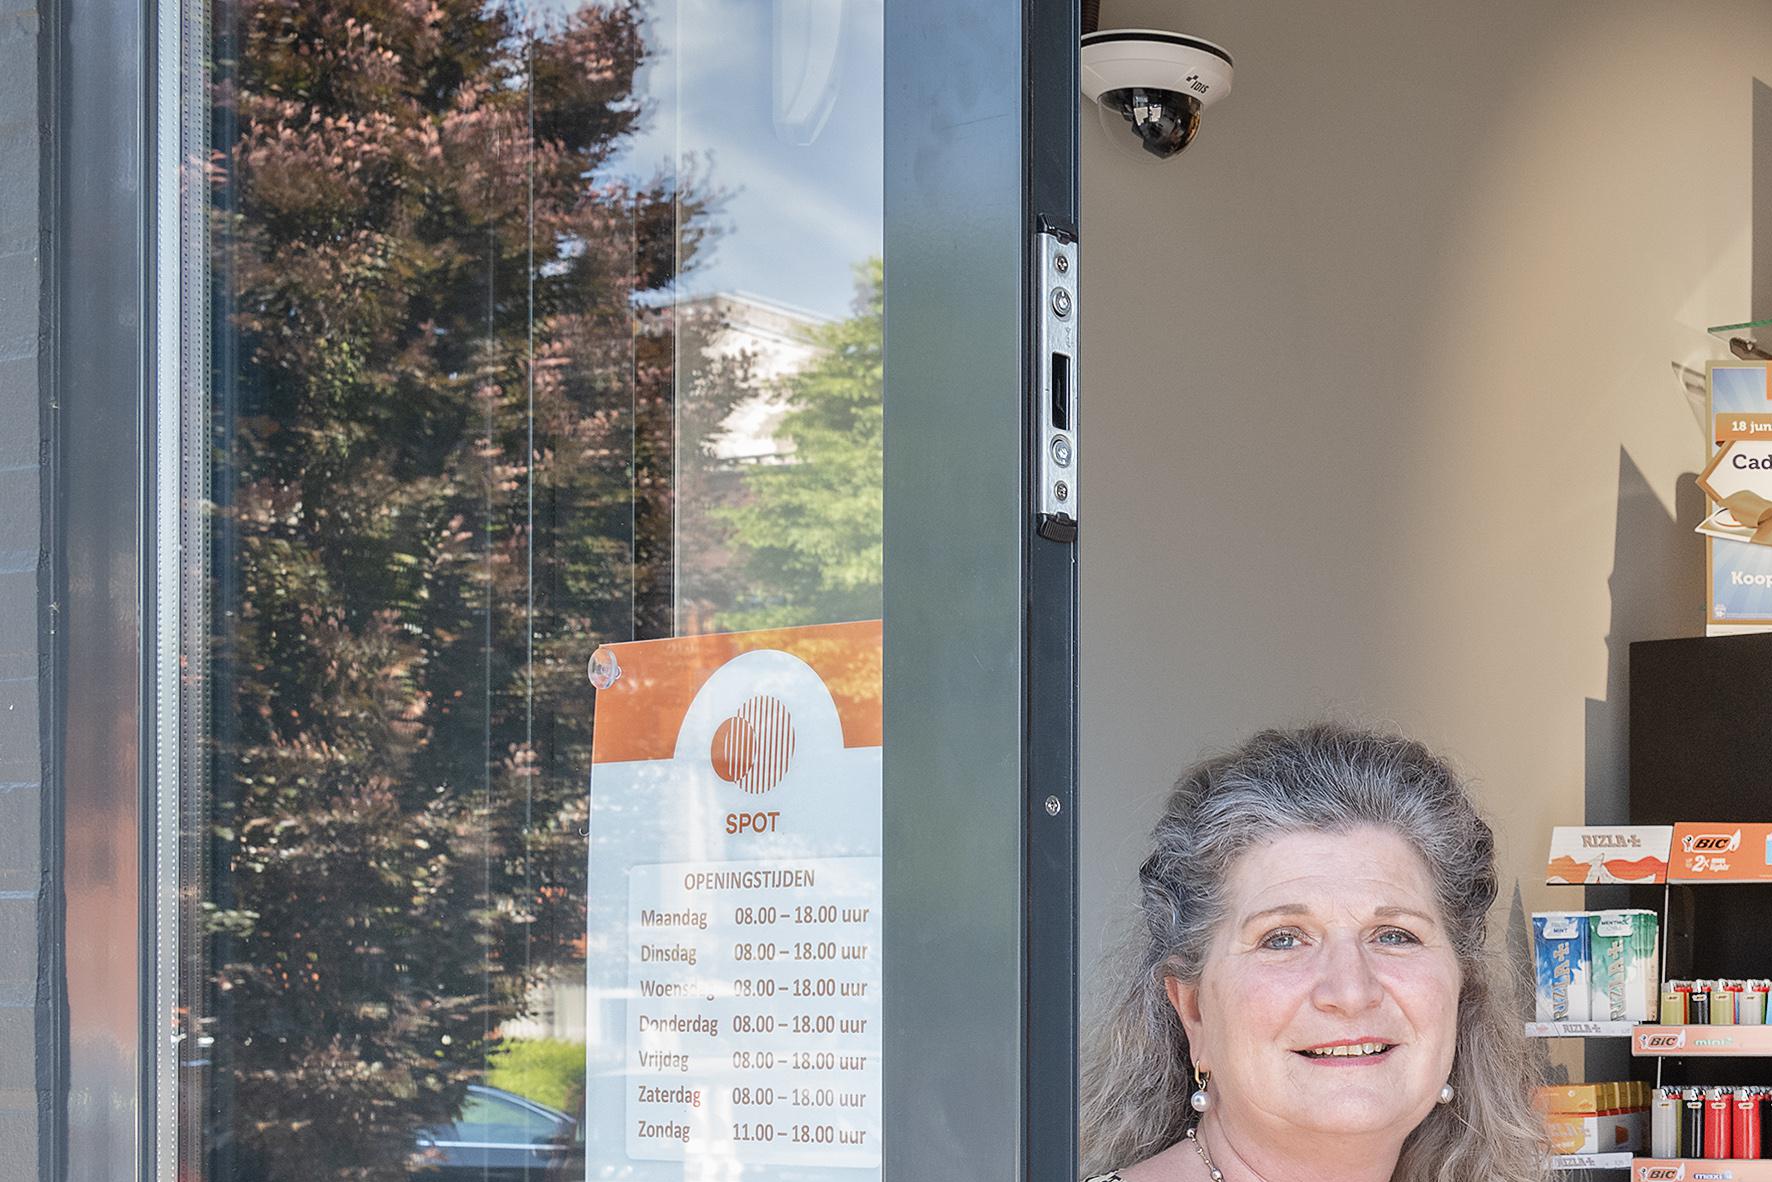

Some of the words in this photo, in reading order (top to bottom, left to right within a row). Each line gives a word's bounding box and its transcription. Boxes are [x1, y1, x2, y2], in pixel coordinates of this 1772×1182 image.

[1732, 422, 1746, 431] 18
[725, 812, 780, 834] SPOT
[684, 870, 814, 890] OPENINGSTIJDEN
[641, 909, 707, 929] Maandag
[735, 907, 776, 924] 08.00
[795, 906, 837, 924] 18.00
[842, 908, 869, 923] uur
[641, 944, 696, 965] Dinsdag
[735, 943, 775, 961] 08.00
[794, 942, 836, 960] 18.00
[841, 944, 868, 960] uur
[735, 979, 774, 997] 08.00
[793, 979, 836, 997] 18.00
[841, 981, 867, 996] uur
[639, 1015, 718, 1036] Donderdag
[733, 1016, 774, 1032] 08.00
[793, 1016, 835, 1033] 18.00
[840, 1018, 867, 1033] uur
[639, 1051, 688, 1072] Vrijdag
[733, 1052, 774, 1069] 08.00
[792, 1052, 834, 1070] 18.00
[840, 1054, 866, 1070] uur
[639, 1086, 701, 1107] Zaterdag
[732, 1088, 773, 1105] 08.00
[792, 1089, 834, 1106] 18.00
[839, 1092, 866, 1107] uur
[639, 1121, 690, 1142] Zondag
[733, 1124, 773, 1141] 11.00
[792, 1125, 833, 1143] 18.00
[839, 1129, 866, 1144] uur
